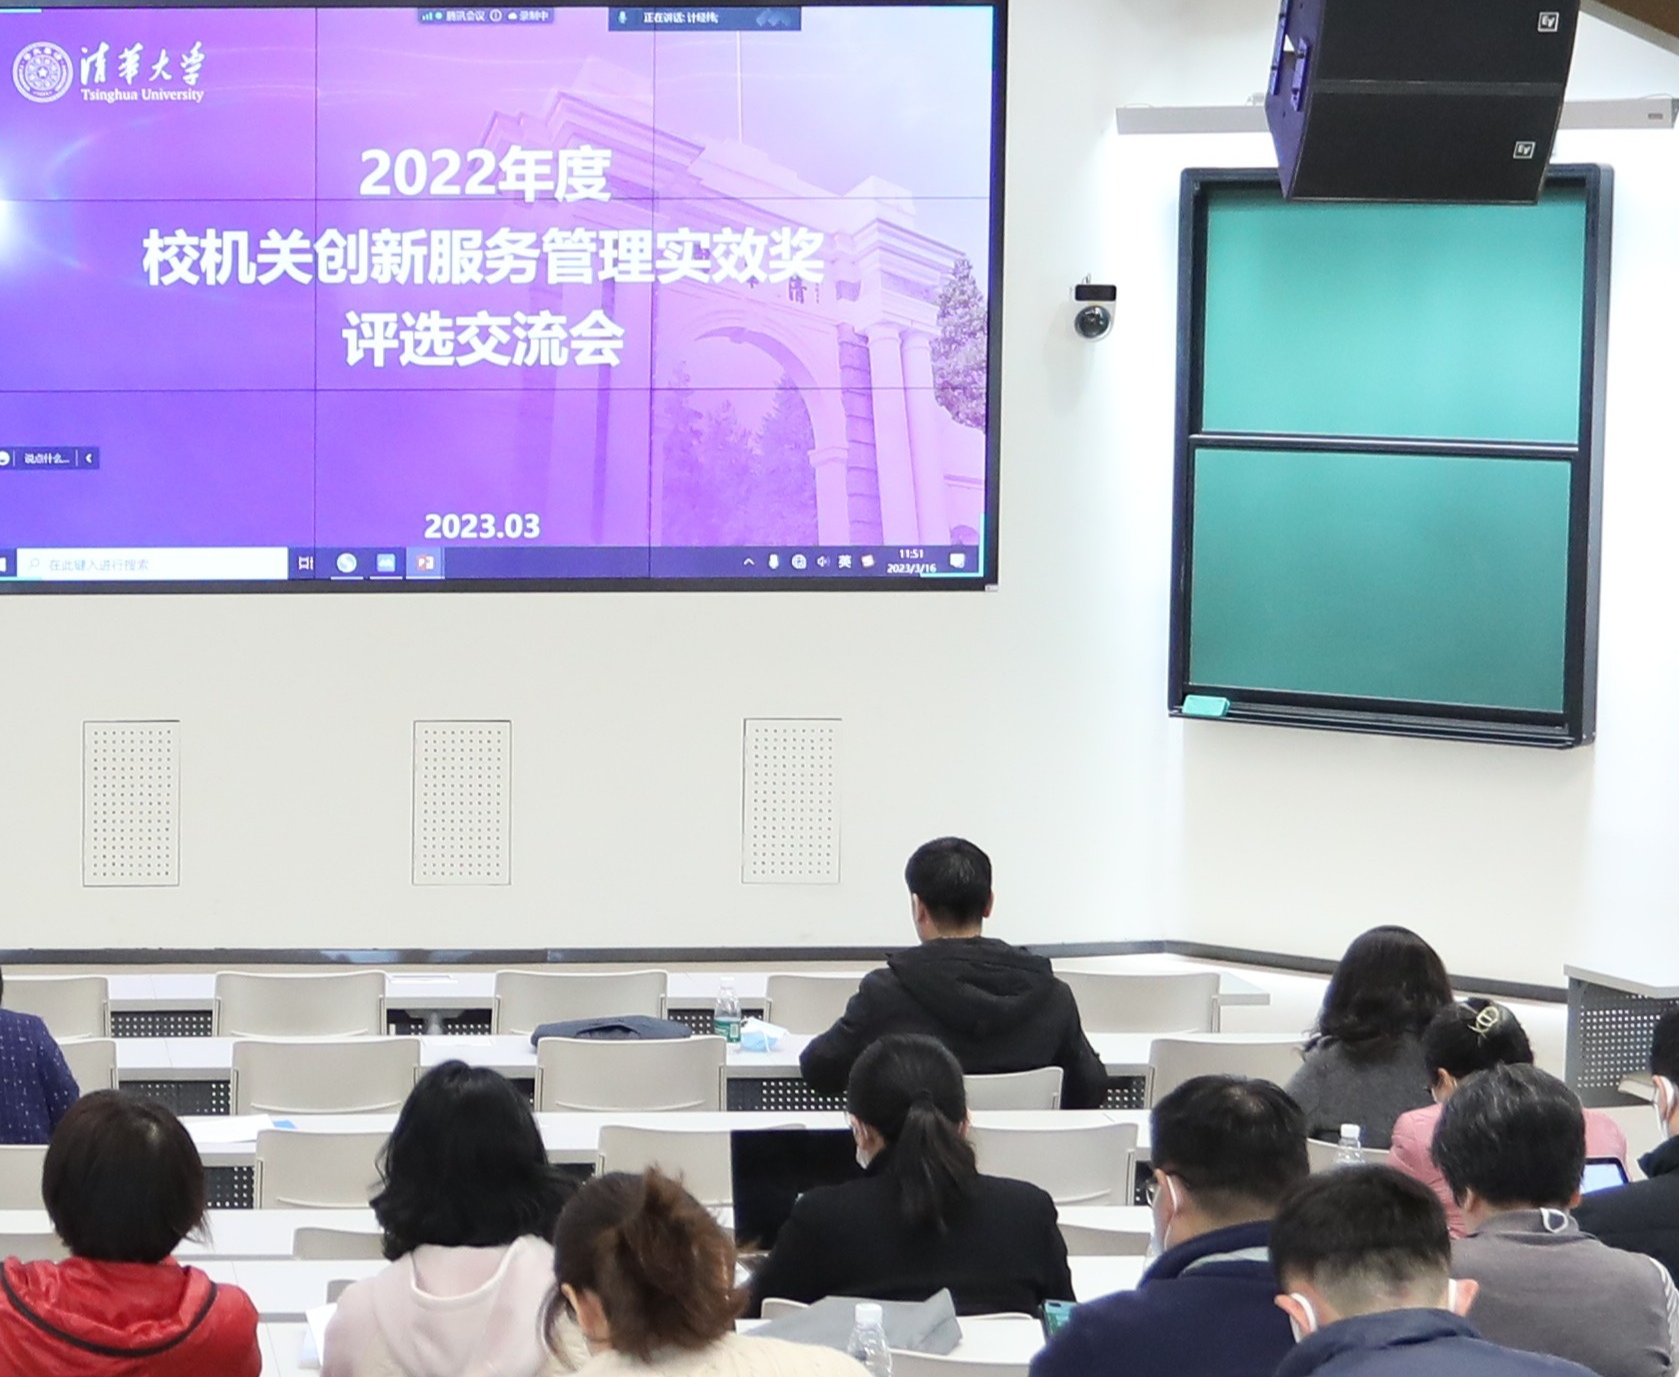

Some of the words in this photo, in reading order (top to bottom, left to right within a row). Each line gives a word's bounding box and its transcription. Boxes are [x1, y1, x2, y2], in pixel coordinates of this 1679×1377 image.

[80, 88, 139, 104] Tsinghua
[141, 88, 205, 104] University
[359, 143, 613, 204] 2022年度
[142, 225, 826, 287] 校机关创新服务管理实效奖
[341, 308, 626, 368] 评选交流会
[423, 512, 541, 540] 2023.03
[898, 548, 925, 559] 11:51
[48, 558, 150, 573] 在此键入进行搜索
[838, 555, 852, 569] 英
[887, 563, 937, 574] 2023/3/16
